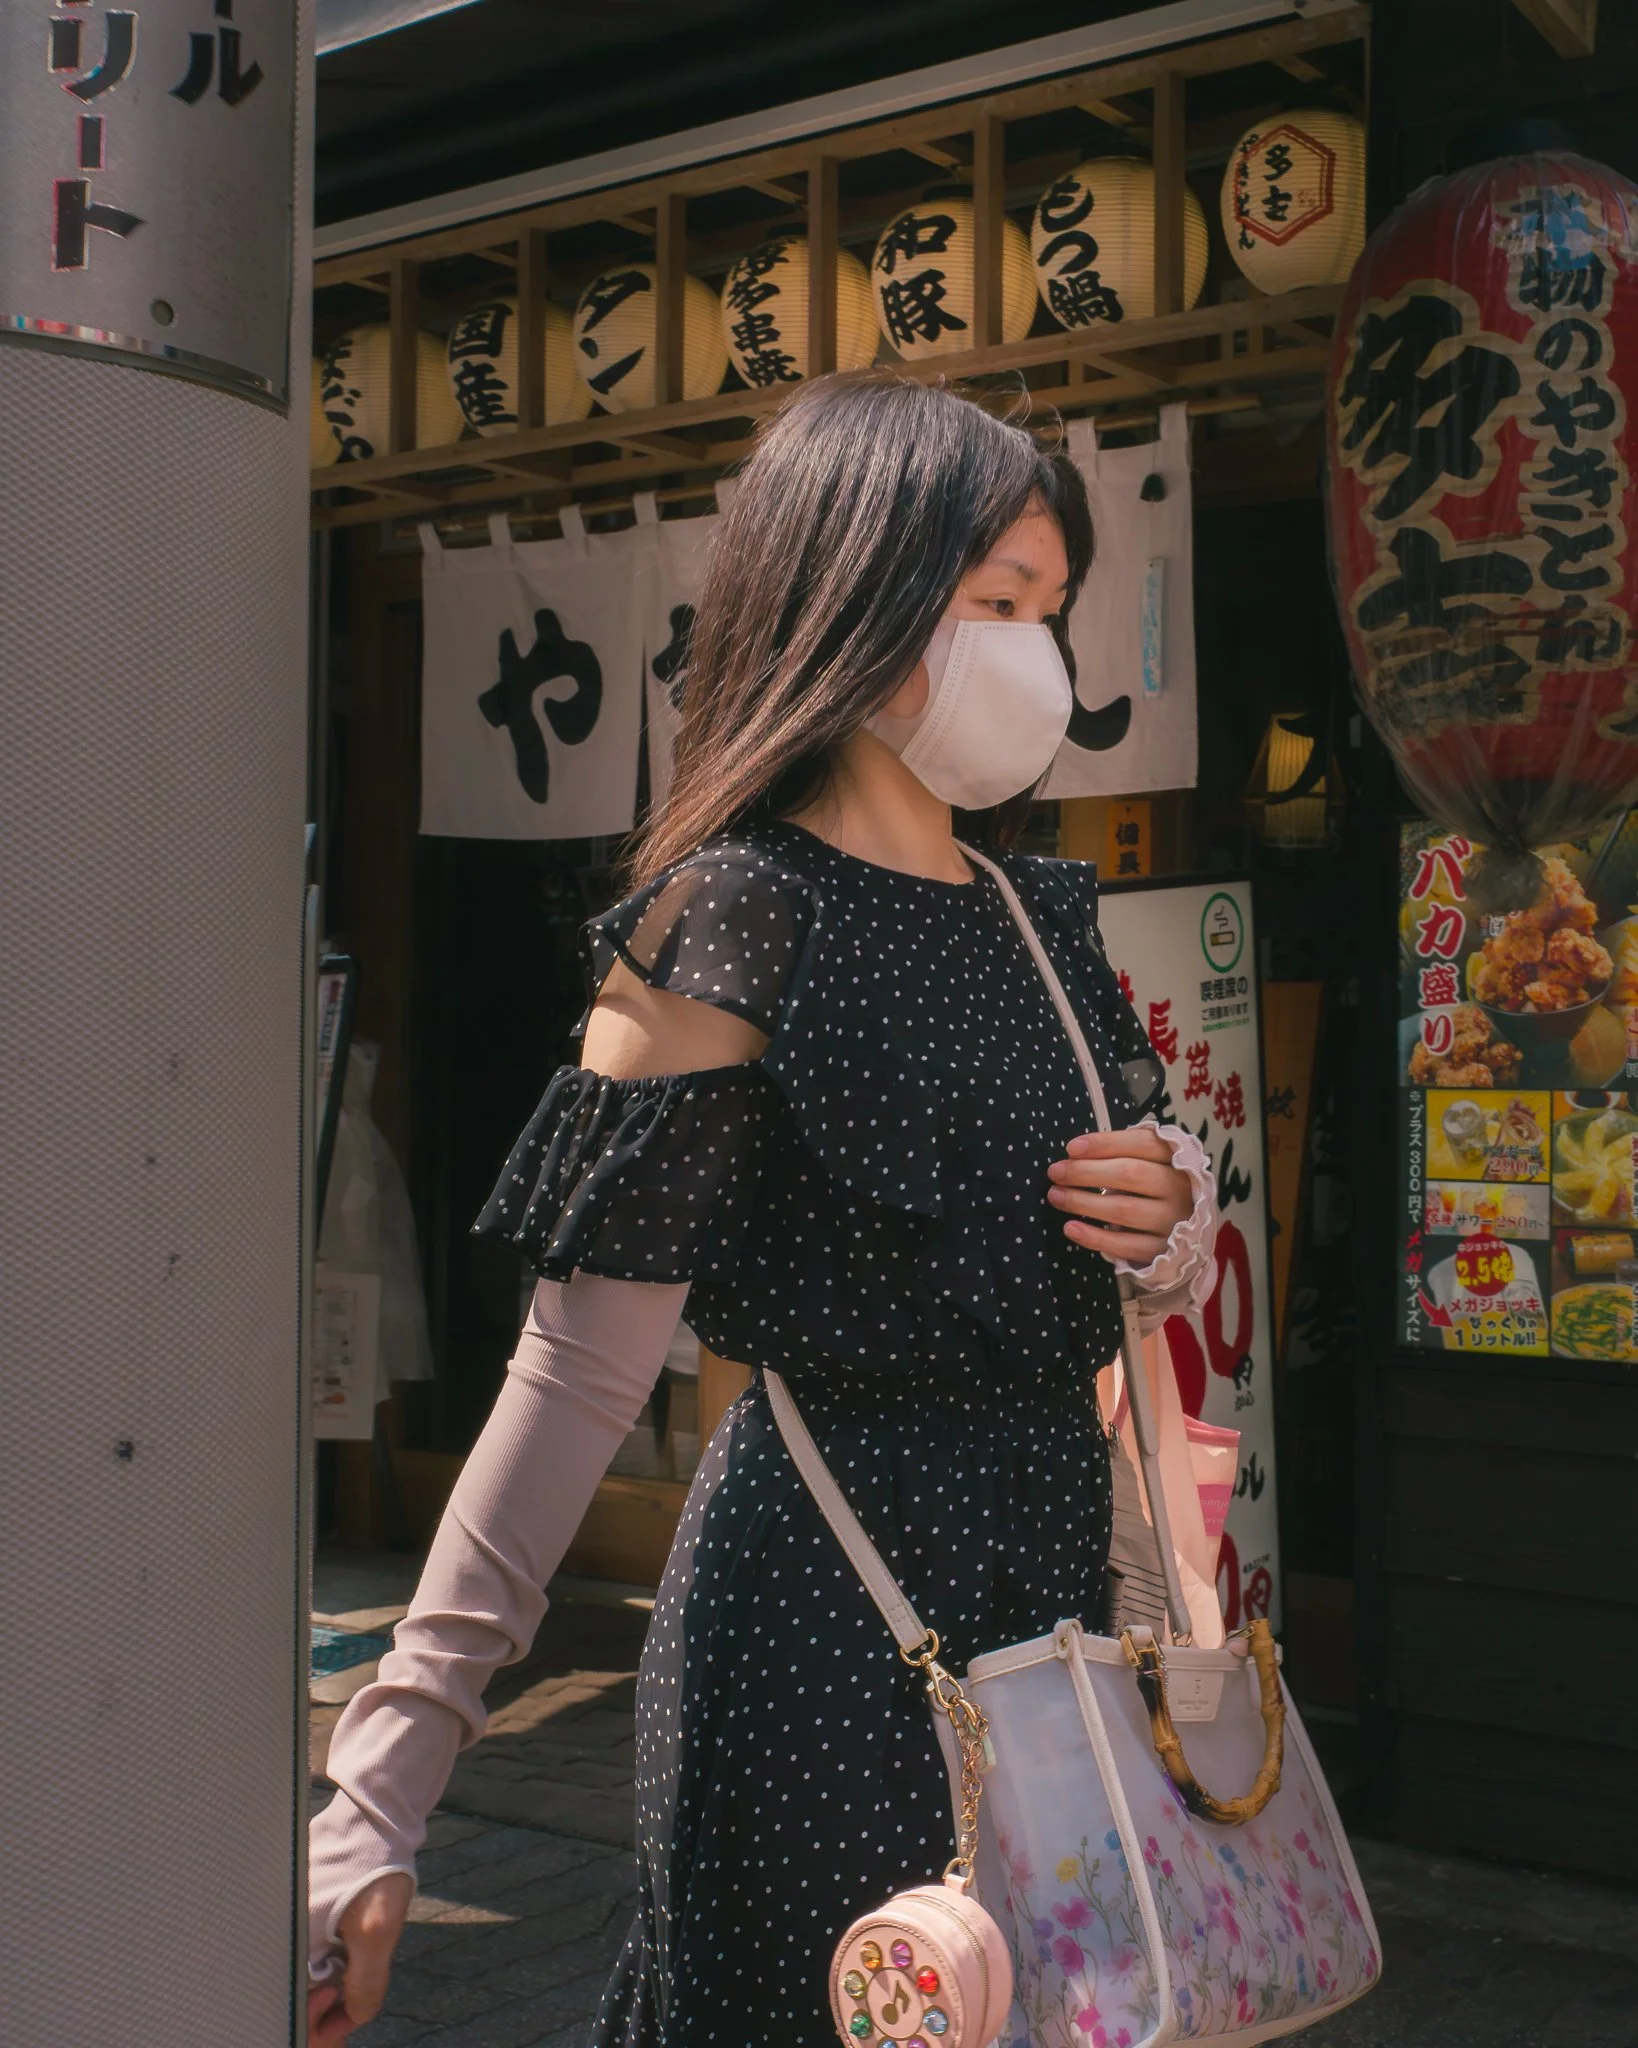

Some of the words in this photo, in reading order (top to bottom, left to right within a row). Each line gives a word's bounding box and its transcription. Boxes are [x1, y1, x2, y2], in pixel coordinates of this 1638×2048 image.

[166, 0, 264, 107] ル
[48, 0, 146, 272] リート
[875, 212, 968, 347] 和豚
[1037, 175, 1125, 329] もつ鍋
[449, 302, 519, 427] 国産
[577, 271, 652, 396] タン
[1411, 836, 1471, 1053] バカ盛り
[1449, 1298, 1541, 1314] メガジョッキ
[1456, 1251, 1515, 1287] 2.5倍
